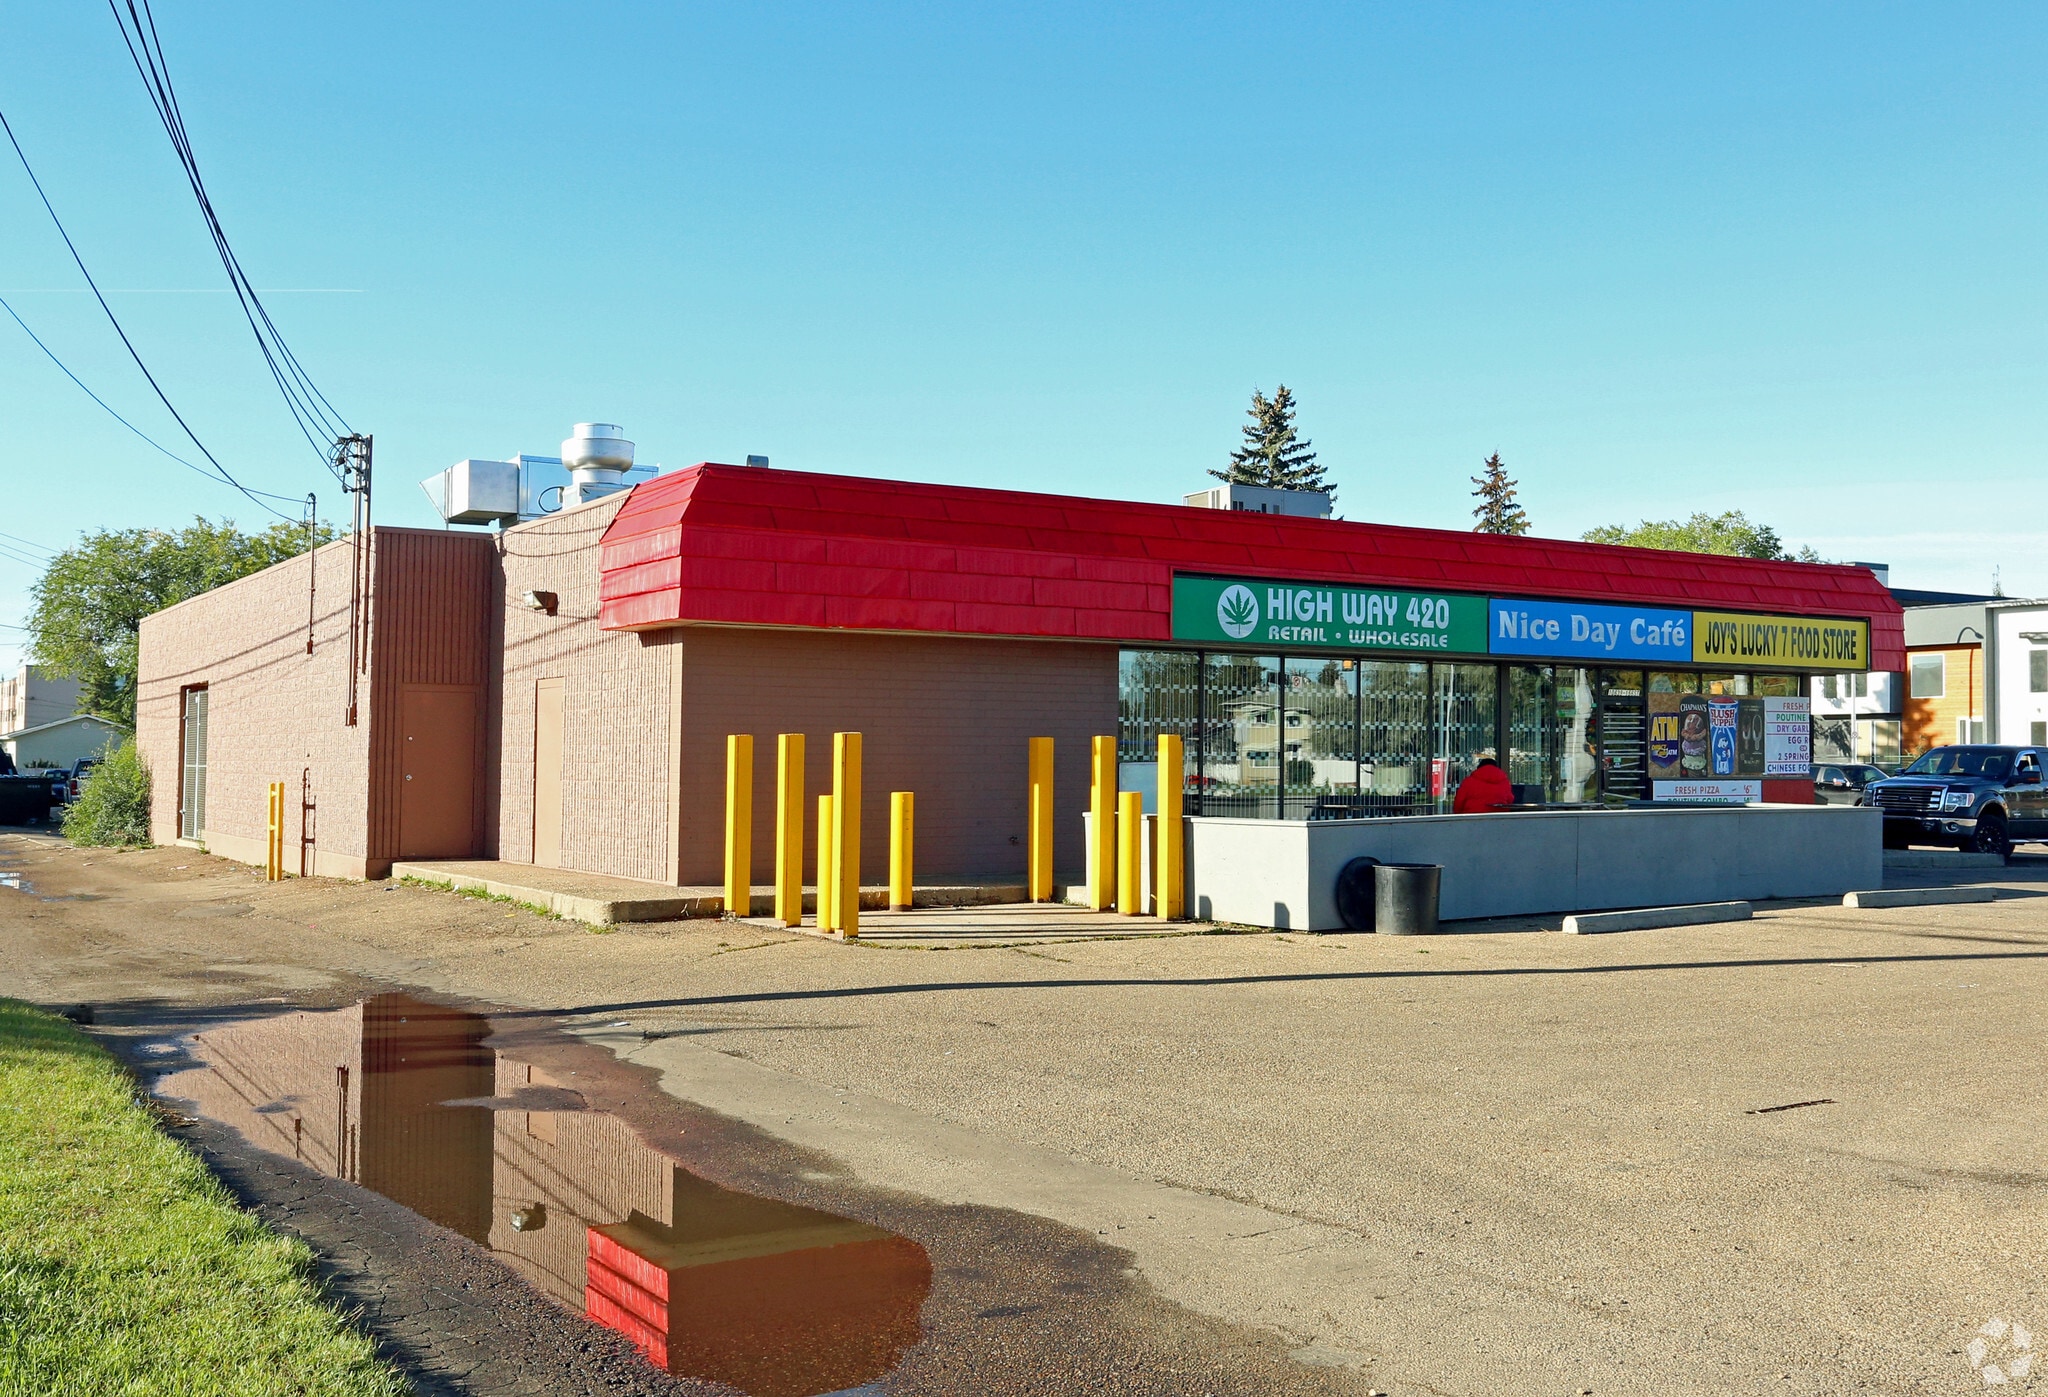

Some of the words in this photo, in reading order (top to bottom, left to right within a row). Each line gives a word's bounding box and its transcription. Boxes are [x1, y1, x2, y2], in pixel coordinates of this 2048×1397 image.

[1267, 587, 1333, 622] HIGH
[1342, 592, 1398, 626] WAY
[1405, 597, 1450, 629] 420
[1498, 610, 1560, 641] Nice
[1570, 615, 1621, 651] Day
[1630, 618, 1686, 648] Café
[1268, 625, 1327, 642] RETAIL
[1348, 629, 1448, 647] WHOLESALE
[1705, 621, 1738, 655] JOY'S
[1741, 623, 1779, 657] LUCKY
[1781, 625, 1788, 657] 7
[1791, 626, 1820, 659] FOOD
[1823, 628, 1857, 660] STORE
[1783, 702, 1804, 710] FRESH
[1776, 713, 1806, 721] POUTINE
[1651, 716, 1679, 741] ATM
[1776, 725, 1790, 733] DRY
[1788, 736, 1802, 744] EGG
[1784, 753, 1809, 761] SPRING
[1767, 764, 1795, 772] CHINESE
[1674, 786, 1697, 794] FRESH
[1699, 786, 1720, 794] PIZZA
